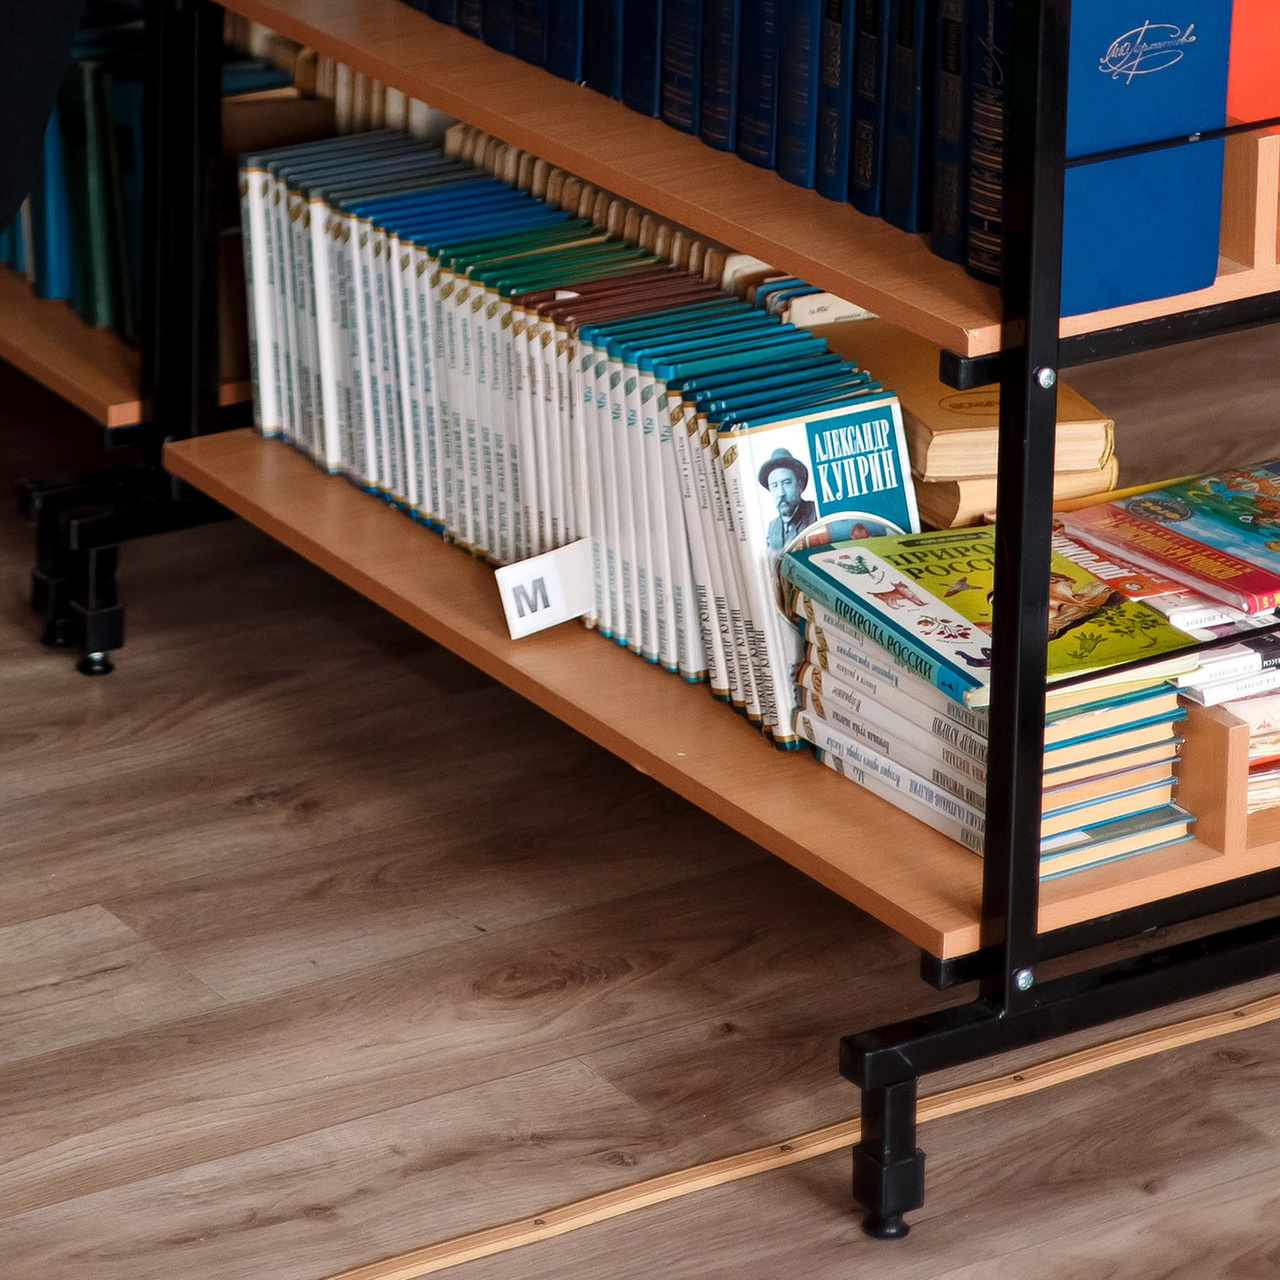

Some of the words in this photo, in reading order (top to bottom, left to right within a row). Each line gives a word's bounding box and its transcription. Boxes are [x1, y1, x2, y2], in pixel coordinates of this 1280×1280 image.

[814, 418, 890, 463] АЛЕКСАНДР
[817, 448, 899, 505] КУПРИН
[885, 541, 996, 567] ПРИРО
[899, 557, 995, 580] РОСС
[511, 576, 552, 619] М
[695, 583, 710, 623] КУПРИН
[714, 595, 730, 635] КУПРИН
[730, 608, 746, 648] КУПРИН
[744, 619, 759, 659] КУПРИН
[834, 596, 885, 646] ПРИРОДА
[886, 628, 935, 681] РОССИИ
[701, 625, 718, 682] АЛЕКСАНДР
[721, 637, 739, 695] АЛЕКСАНДР
[754, 629, 770, 669] КУПРИН
[738, 650, 755, 708] АЛЕКСАНДР
[752, 661, 769, 719] АЛЕКСАНДР
[763, 671, 780, 729] АЛЕКСАНДР
[931, 716, 959, 745] КУПРИН
[851, 765, 865, 785] Мы
